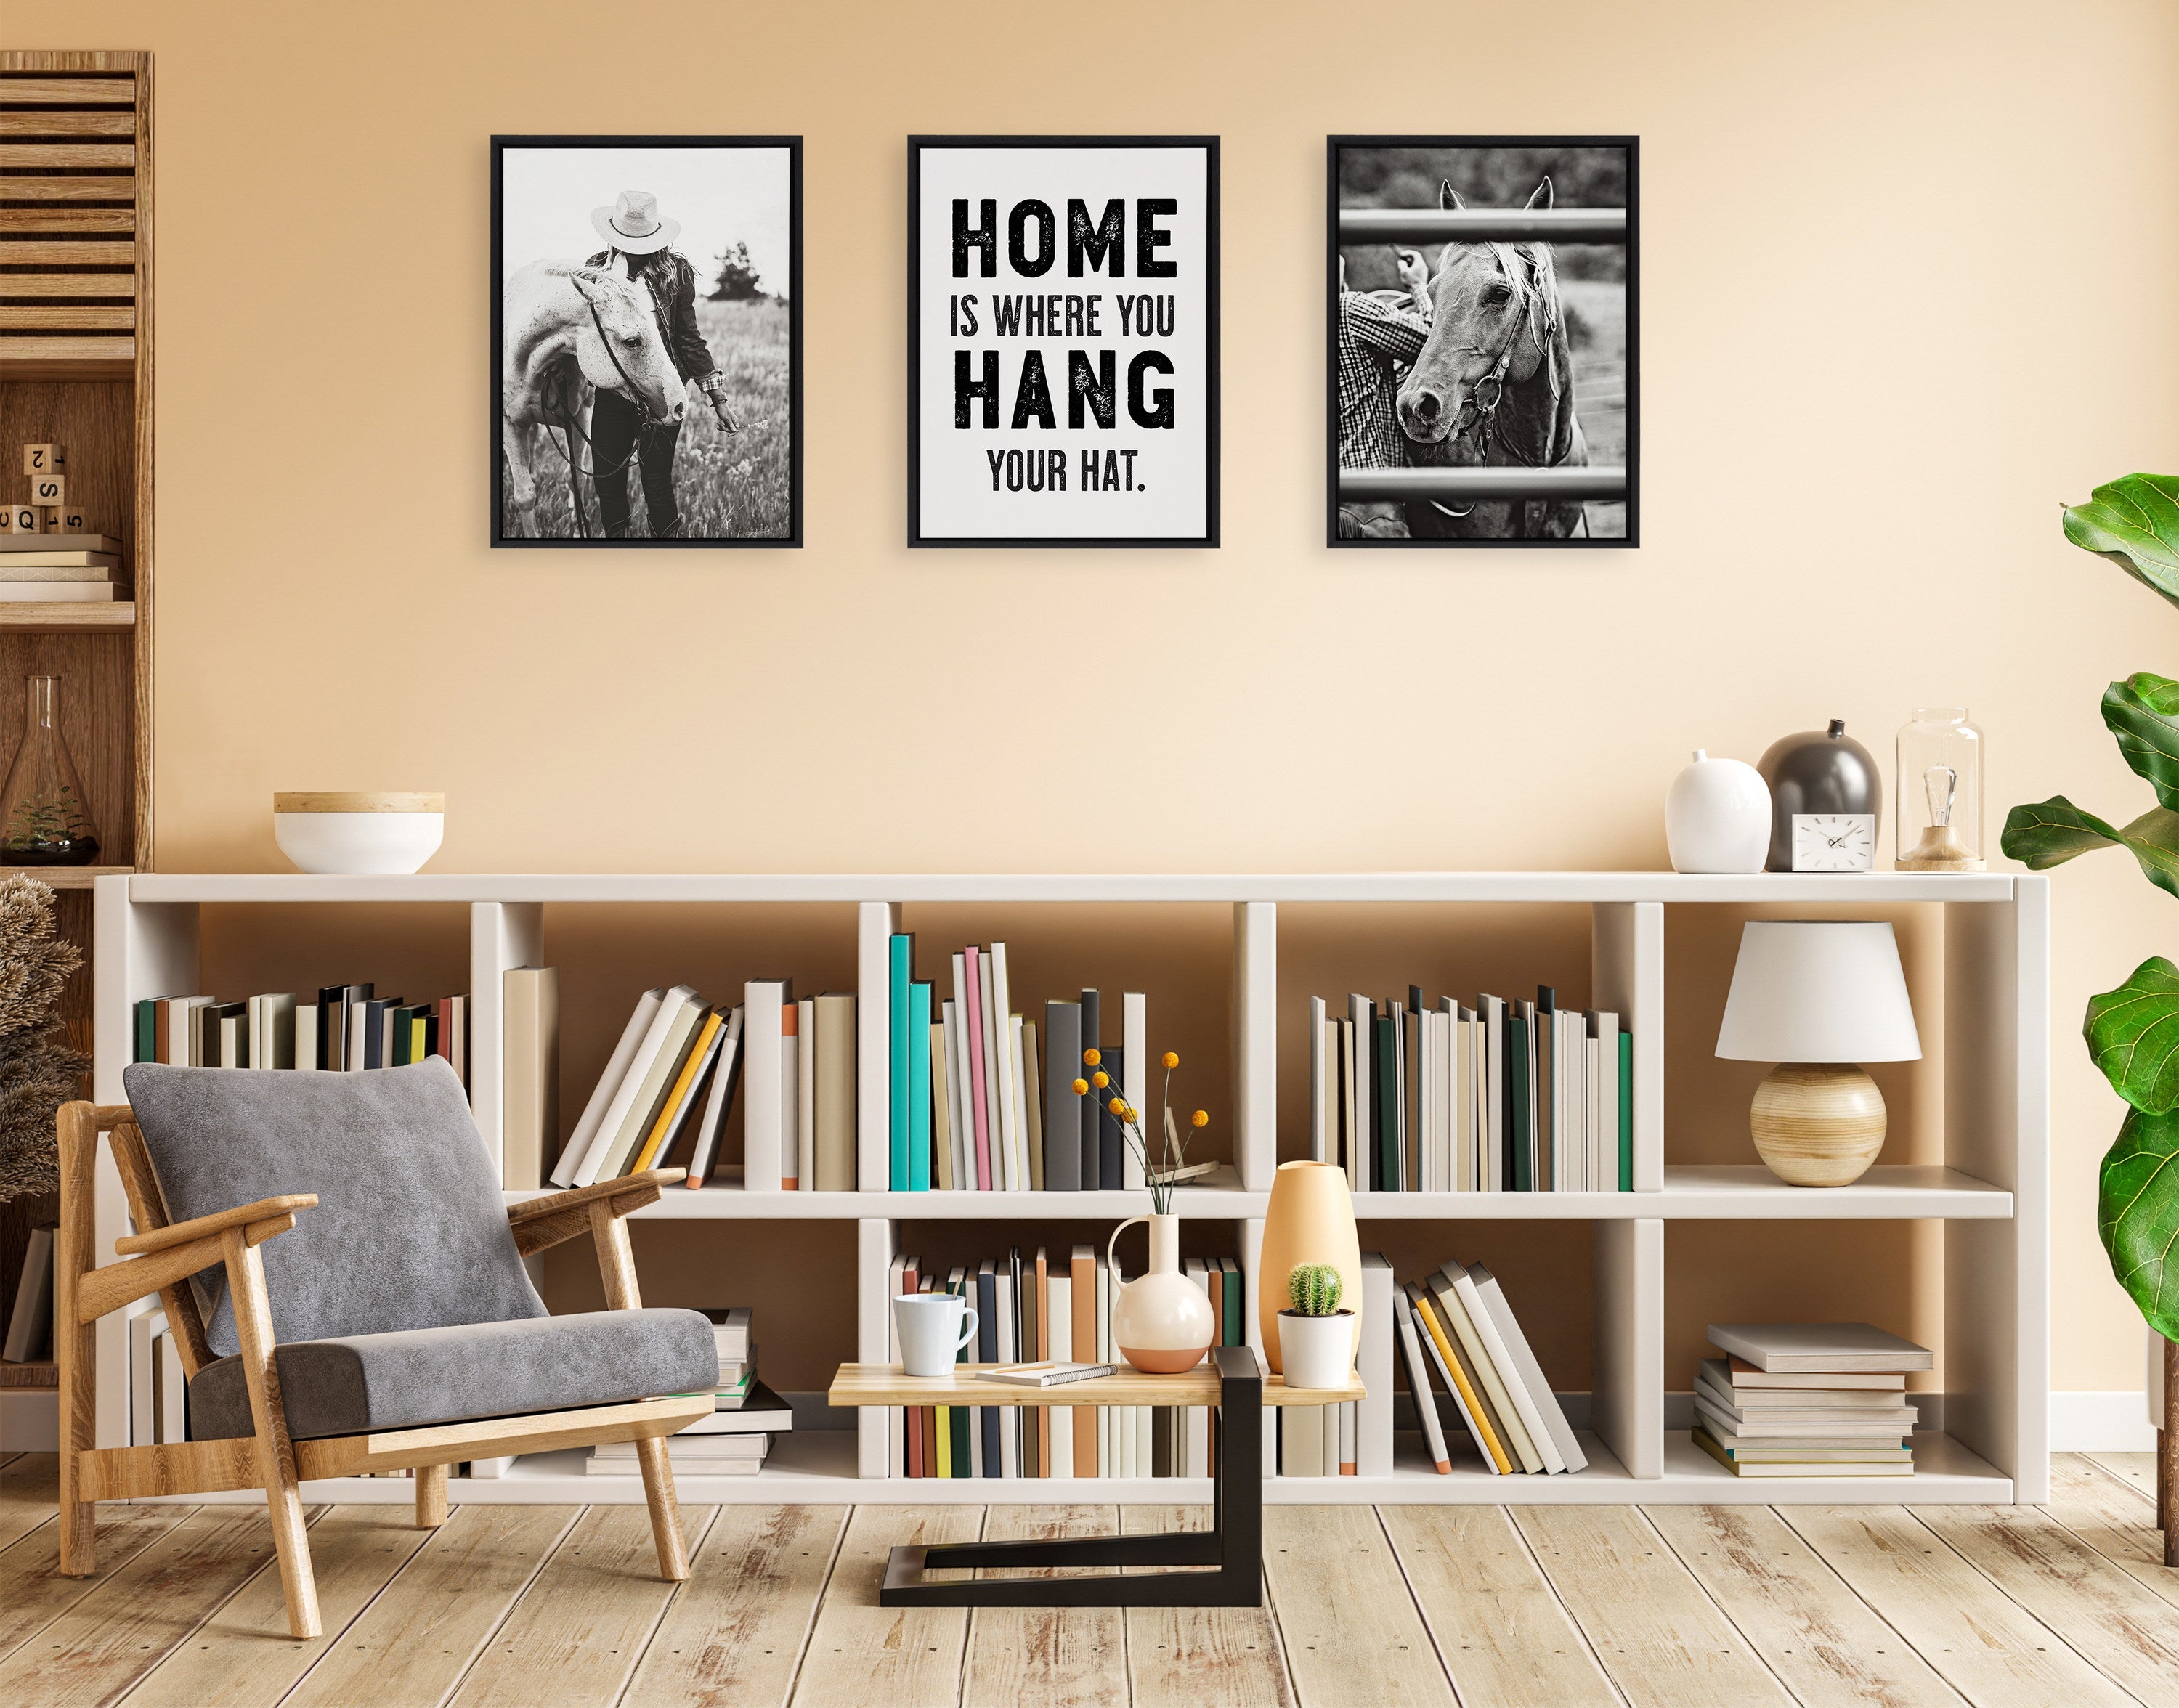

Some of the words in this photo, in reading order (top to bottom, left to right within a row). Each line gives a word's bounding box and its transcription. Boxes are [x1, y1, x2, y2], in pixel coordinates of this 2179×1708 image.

[951, 198, 1177, 278] HOME
[951, 294, 978, 337] IS
[991, 294, 1103, 337] WHERE
[1116, 294, 1175, 337] YOU
[954, 349, 1175, 430] HANG
[986, 449, 1067, 492] YOUR
[1081, 449, 1145, 492] HAT.
[18, 511, 34, 530] Q
